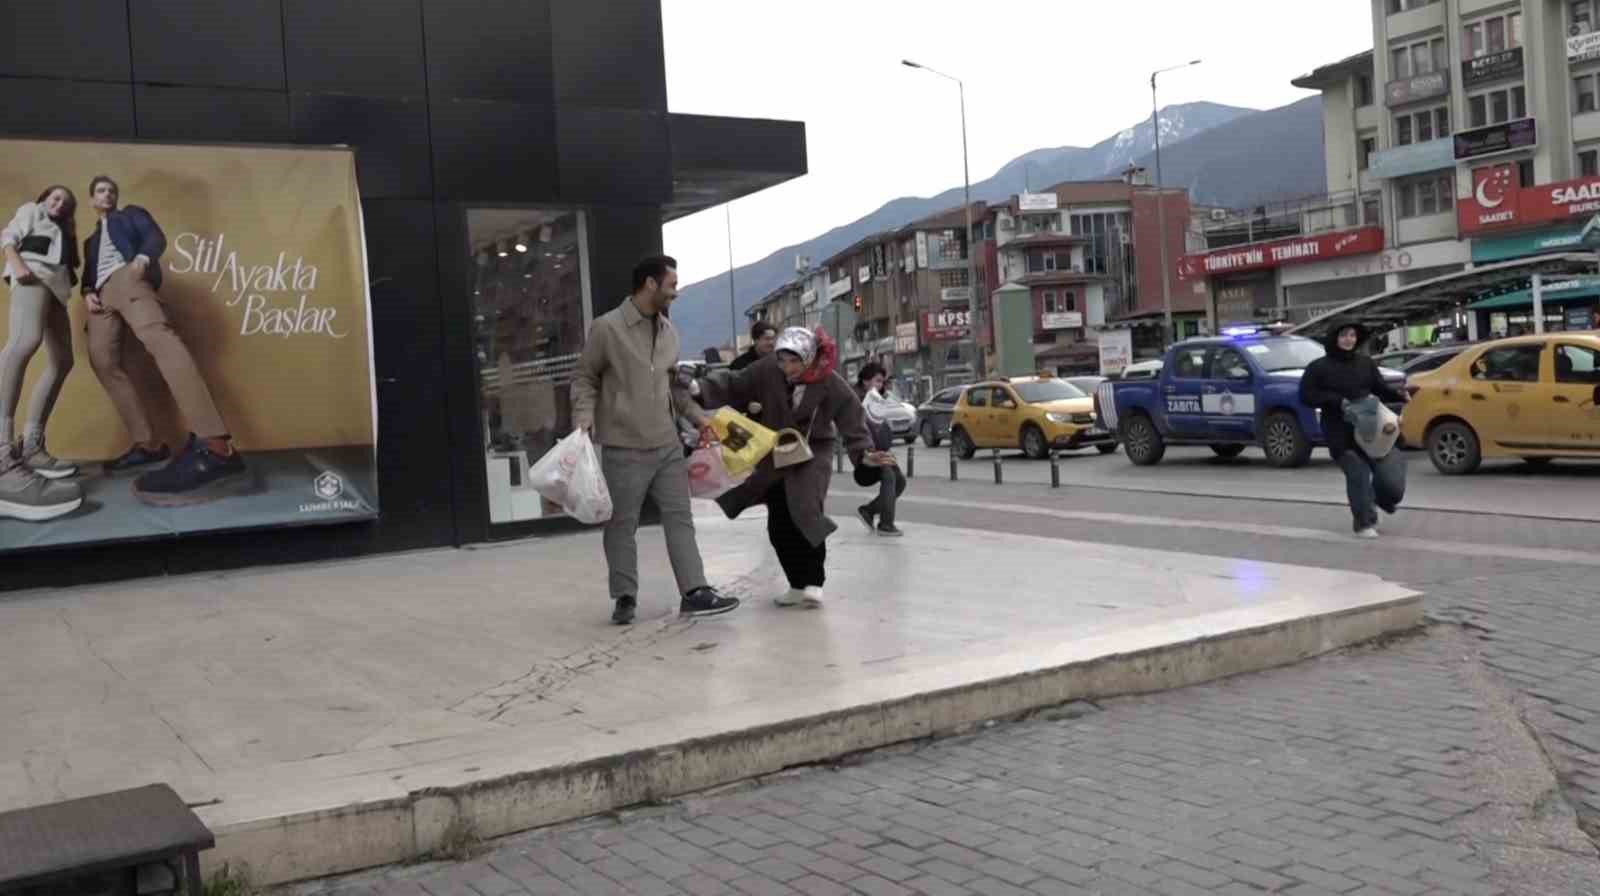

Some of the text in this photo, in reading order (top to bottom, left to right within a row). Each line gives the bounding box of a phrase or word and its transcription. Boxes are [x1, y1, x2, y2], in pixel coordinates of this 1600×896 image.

[169, 232, 224, 273] Stil
[1203, 249, 1263, 271] TÜRKİYE'NİN
[1272, 241, 1319, 261] TEMİNATI
[211, 251, 319, 307] Ayakta
[240, 294, 349, 338] Başlar
[1167, 399, 1201, 412] ZABITA
